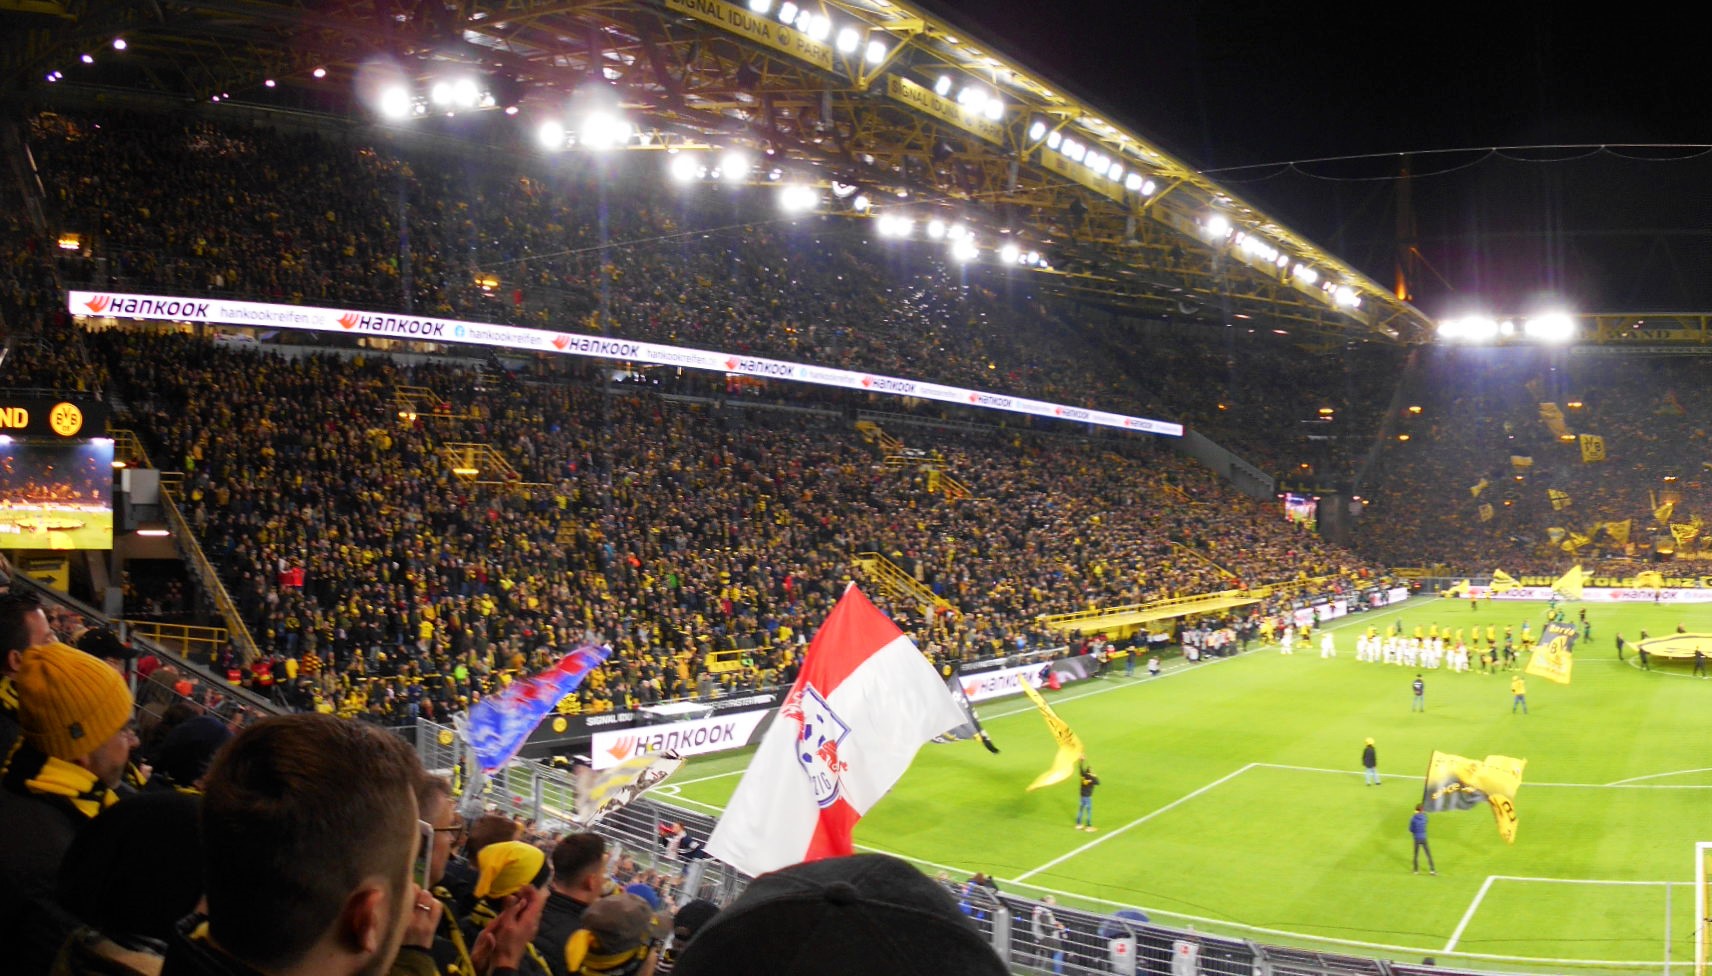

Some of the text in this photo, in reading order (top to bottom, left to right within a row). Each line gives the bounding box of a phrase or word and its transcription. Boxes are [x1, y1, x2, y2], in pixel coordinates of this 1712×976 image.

[672, 0, 830, 63] GNAL IDUNA PARK
[892, 77, 929, 107] SIGNAL
[468, 328, 543, 345] hankookreifen
[1584, 576, 1696, 588] TOLEANZ
[1621, 590, 1678, 600] HANKOK
[585, 713, 618, 726] SIGNAL
[635, 722, 736, 757] HANKOOK
